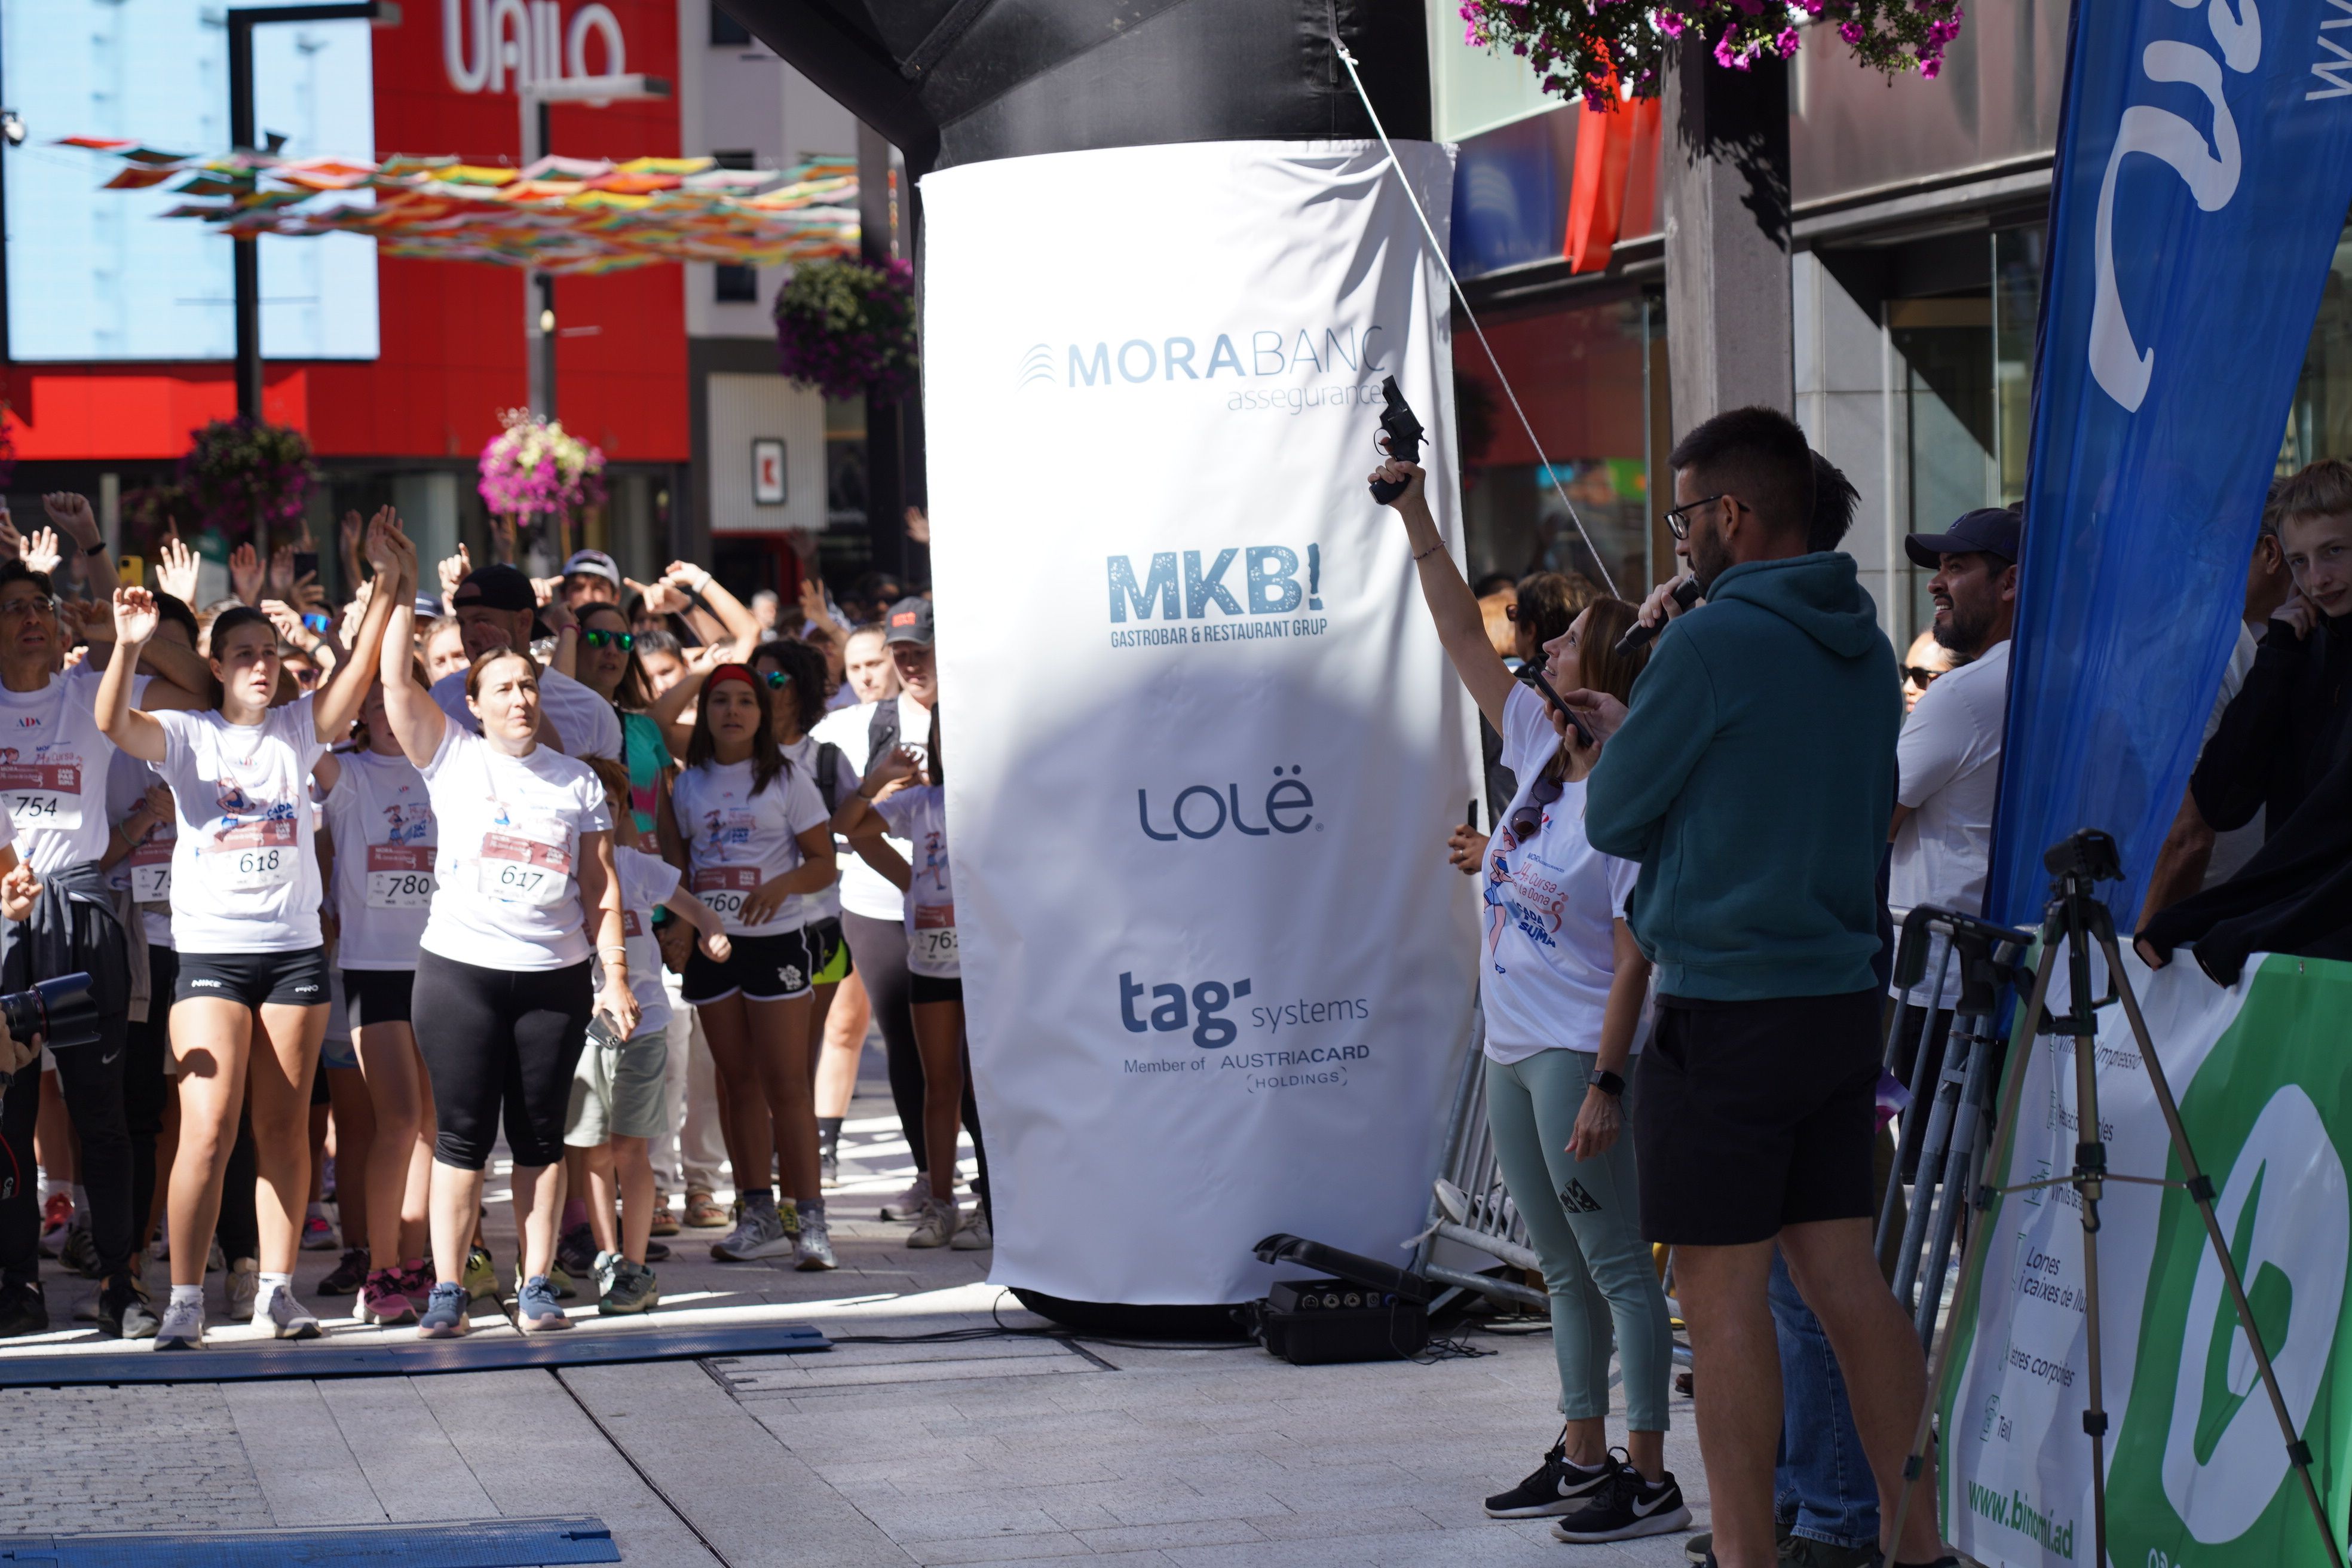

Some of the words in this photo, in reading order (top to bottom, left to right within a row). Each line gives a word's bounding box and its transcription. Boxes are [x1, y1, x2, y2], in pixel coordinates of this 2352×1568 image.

[1067, 325, 1386, 388] MORABANC
[1228, 384, 1387, 415] assegurance
[1107, 542, 1324, 623] MKB!
[1110, 627, 1187, 648] GASTROBAR
[1192, 626, 1200, 642] &
[1205, 620, 1290, 642] RESTAURANT
[1293, 618, 1328, 636] GRUP
[15, 797, 57, 817] 754
[240, 850, 279, 873] 618
[387, 875, 430, 897] 780
[501, 865, 544, 892] 617
[1529, 873, 1557, 893] Cursa
[703, 893, 741, 912] 760
[1527, 887, 1550, 905] Dona
[191, 979, 222, 988] NIKE
[1252, 999, 1369, 1034] systems
[1124, 1060, 1186, 1073] Member
[1190, 1057, 1206, 1071] of
[1220, 1045, 1370, 1070] AUSTRIACARD
[2026, 1246, 2061, 1275] Lones
[2019, 1270, 2026, 1291] i
[2024, 1276, 2061, 1303] caixes
[2060, 1285, 2073, 1307] de
[1969, 1480, 2074, 1560] www.binomi.ad
